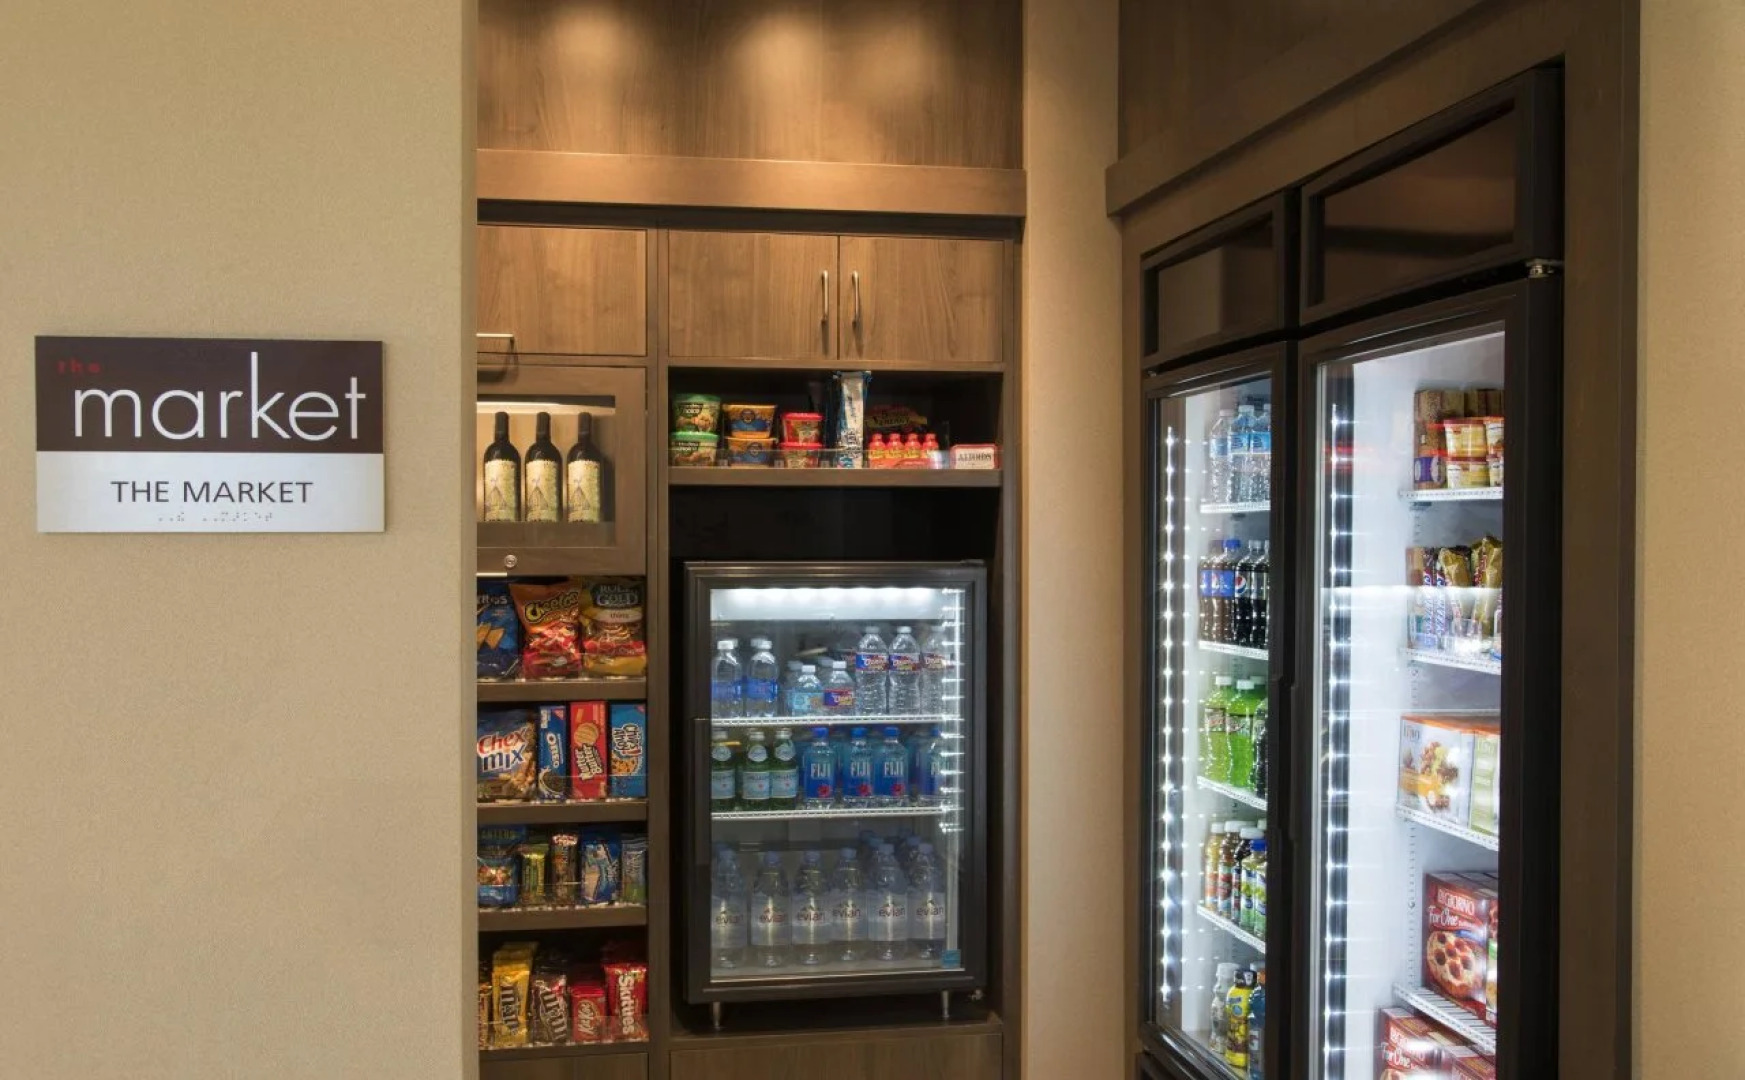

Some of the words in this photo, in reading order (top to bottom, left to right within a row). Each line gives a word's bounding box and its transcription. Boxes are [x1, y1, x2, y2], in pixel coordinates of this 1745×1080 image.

[74, 351, 367, 441] market
[111, 481, 169, 503] THE
[183, 481, 313, 503] MARKET
[597, 593, 638, 606] GOLD
[477, 726, 527, 756] Chex
[546, 732, 560, 768] OREO
[810, 763, 831, 778] FIJI
[850, 762, 870, 777] FIJI
[884, 761, 904, 777] FIJI
[715, 910, 744, 924] evian
[797, 910, 825, 923] evian
[832, 906, 861, 919] evian
[878, 906, 906, 918] evian
[916, 905, 944, 917] evian
[618, 974, 636, 1035] Skittles
